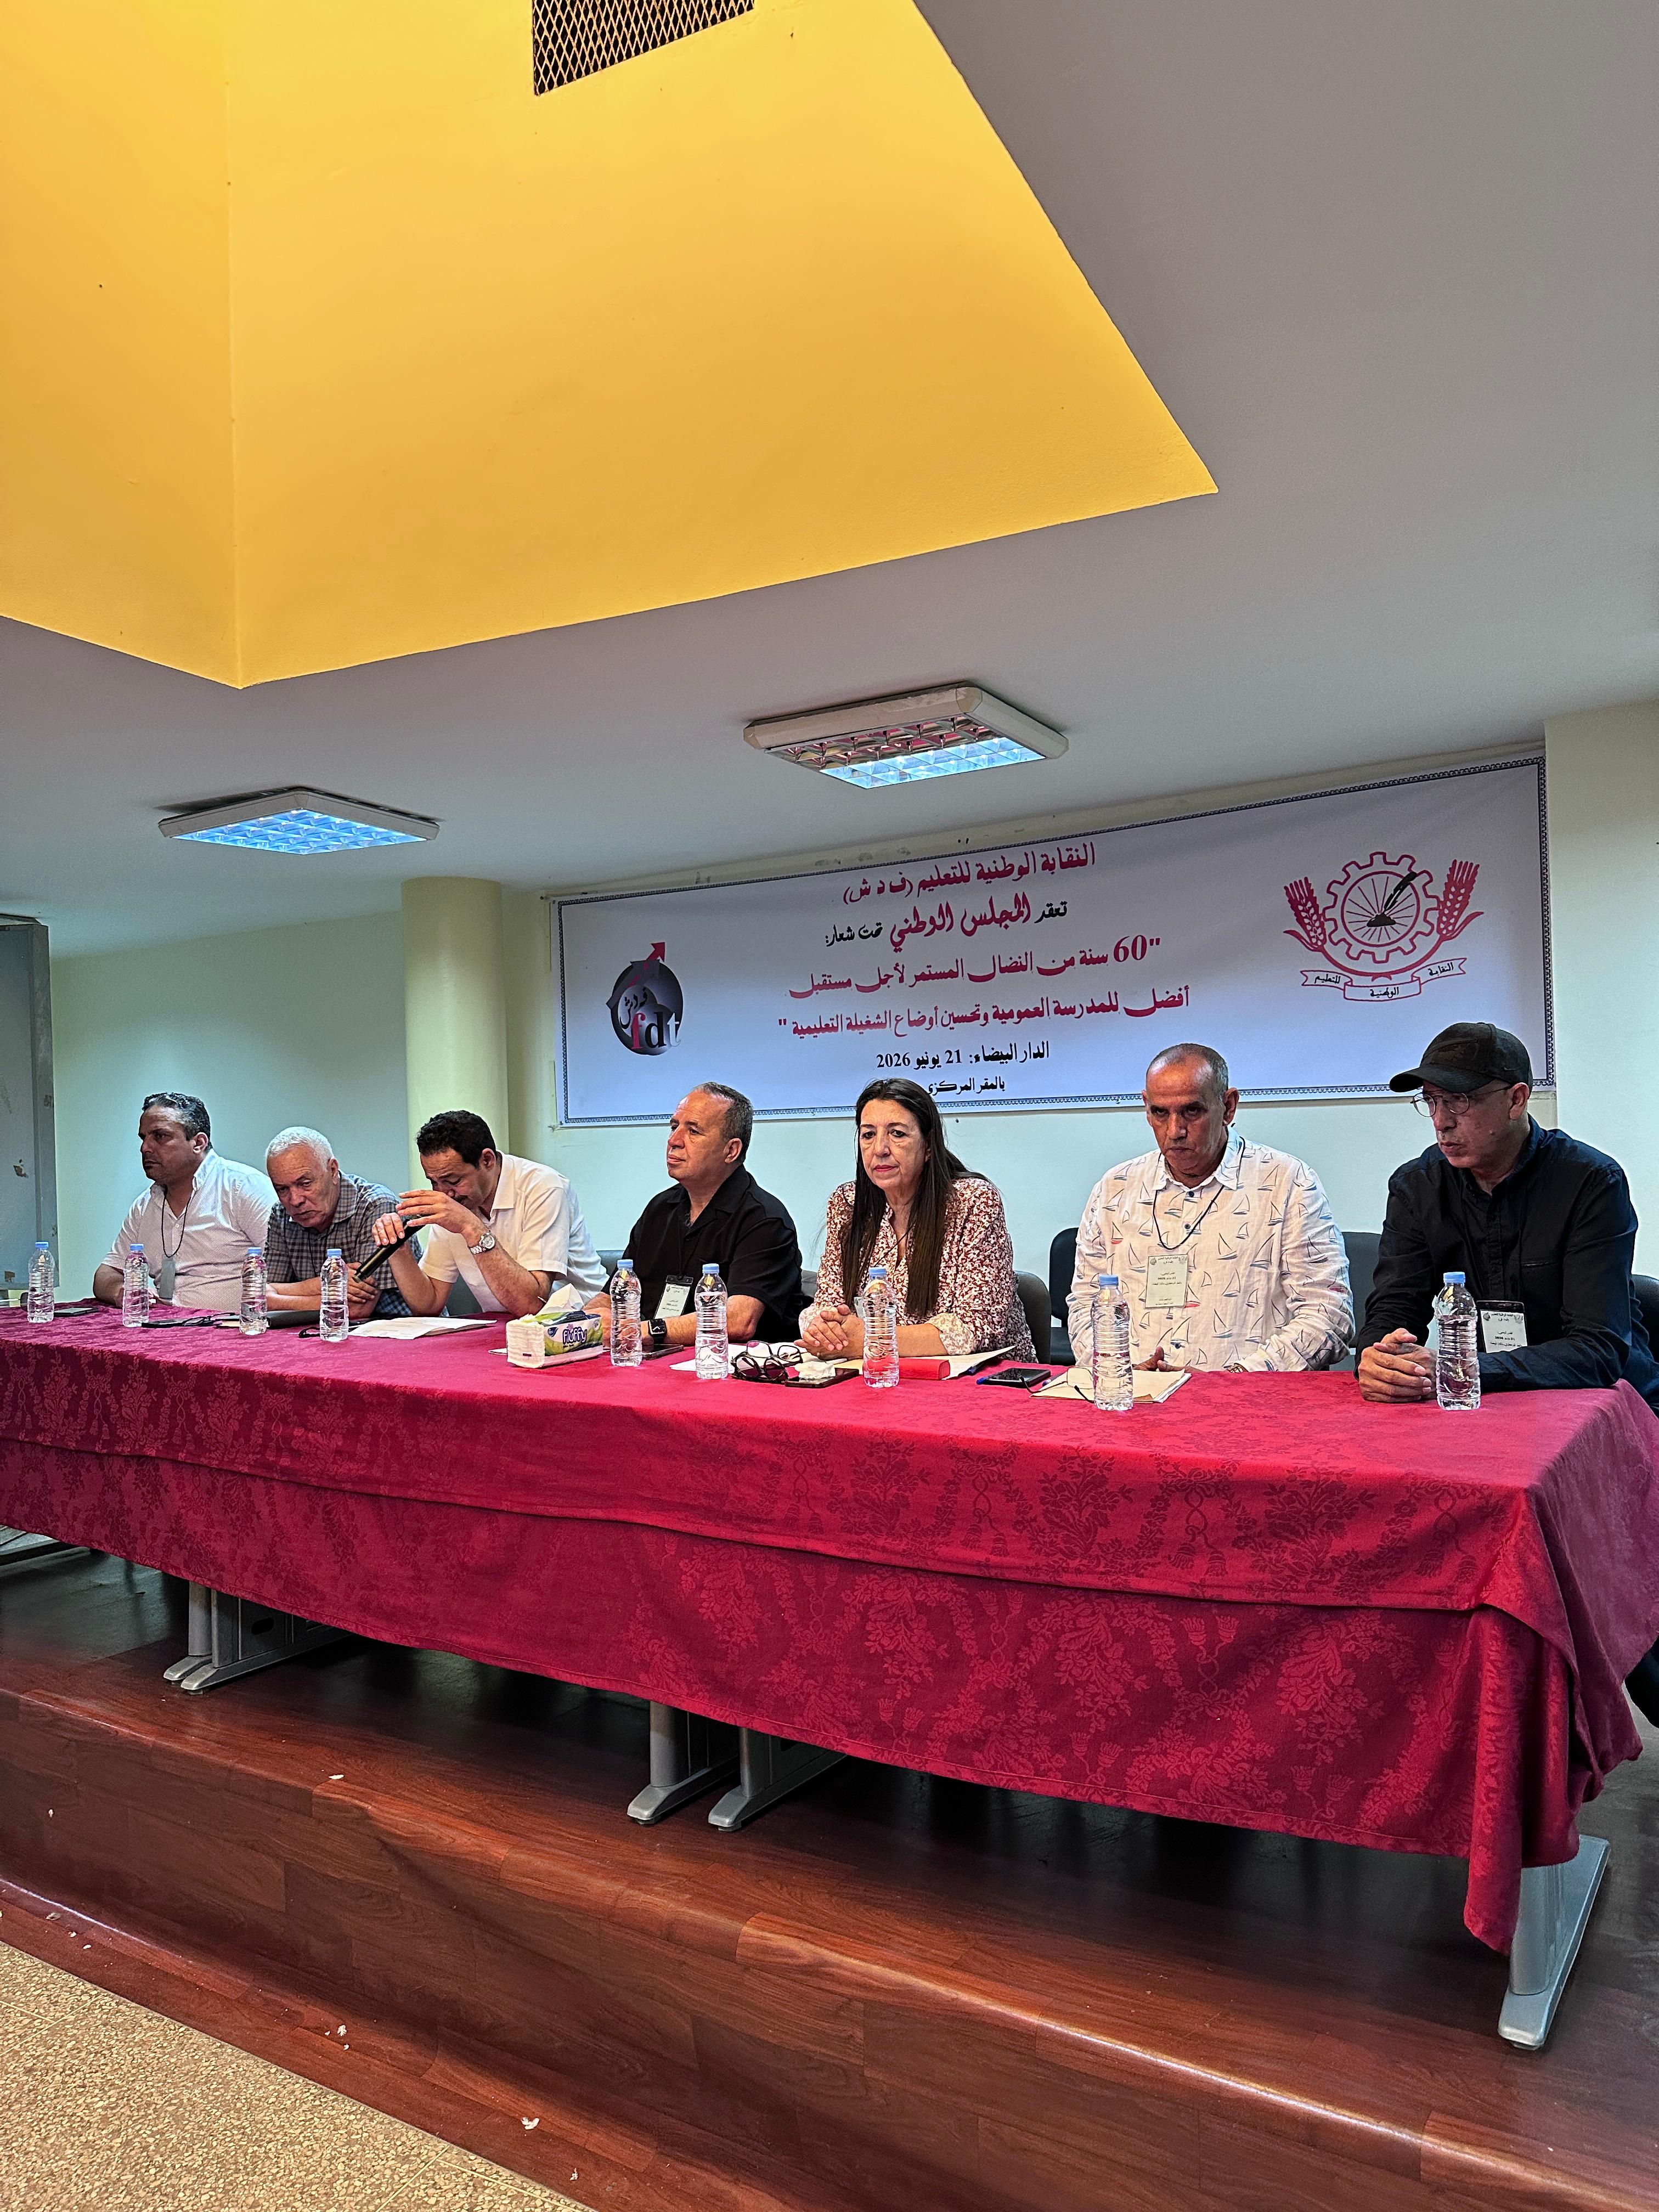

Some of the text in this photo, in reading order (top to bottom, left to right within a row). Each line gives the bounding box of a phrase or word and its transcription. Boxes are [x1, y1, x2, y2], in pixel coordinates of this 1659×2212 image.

[977, 851, 1036, 884] الوطنية
[1041, 842, 1095, 874] النقابة
[917, 861, 970, 897] للتعليم
[961, 891, 1031, 936] المجلس
[1034, 900, 1068, 923] تعقد
[825, 924, 855, 946] شعار:
[890, 901, 954, 953] الوطني
[967, 951, 1033, 983] النضال
[1036, 955, 1075, 976] من
[1079, 948, 1109, 966] سنة
[1427, 962, 1454, 977] النقابة
[789, 973, 852, 998] مستقبل
[855, 962, 905, 993] لأجل
[909, 957, 964, 988] المستمر
[1313, 974, 1341, 985] للتعليم
[1053, 991, 1119, 1019] للمدرسة
[1123, 985, 1189, 1018] أفضل
[1370, 986, 1399, 998] الوطنية
[845, 1009, 891, 1035] الشغيلة
[894, 1006, 938, 1037] أوضاع
[941, 1003, 989, 1030] وتحسين
[992, 997, 1050, 1024] العمومية
[631, 1012, 681, 1049] fdt
[792, 1013, 843, 1039] التعليمية
[876, 1040, 1049, 1070] الدار البيضاء: 21 يونيو 2026
[976, 1076, 1006, 1093] بالمقر
